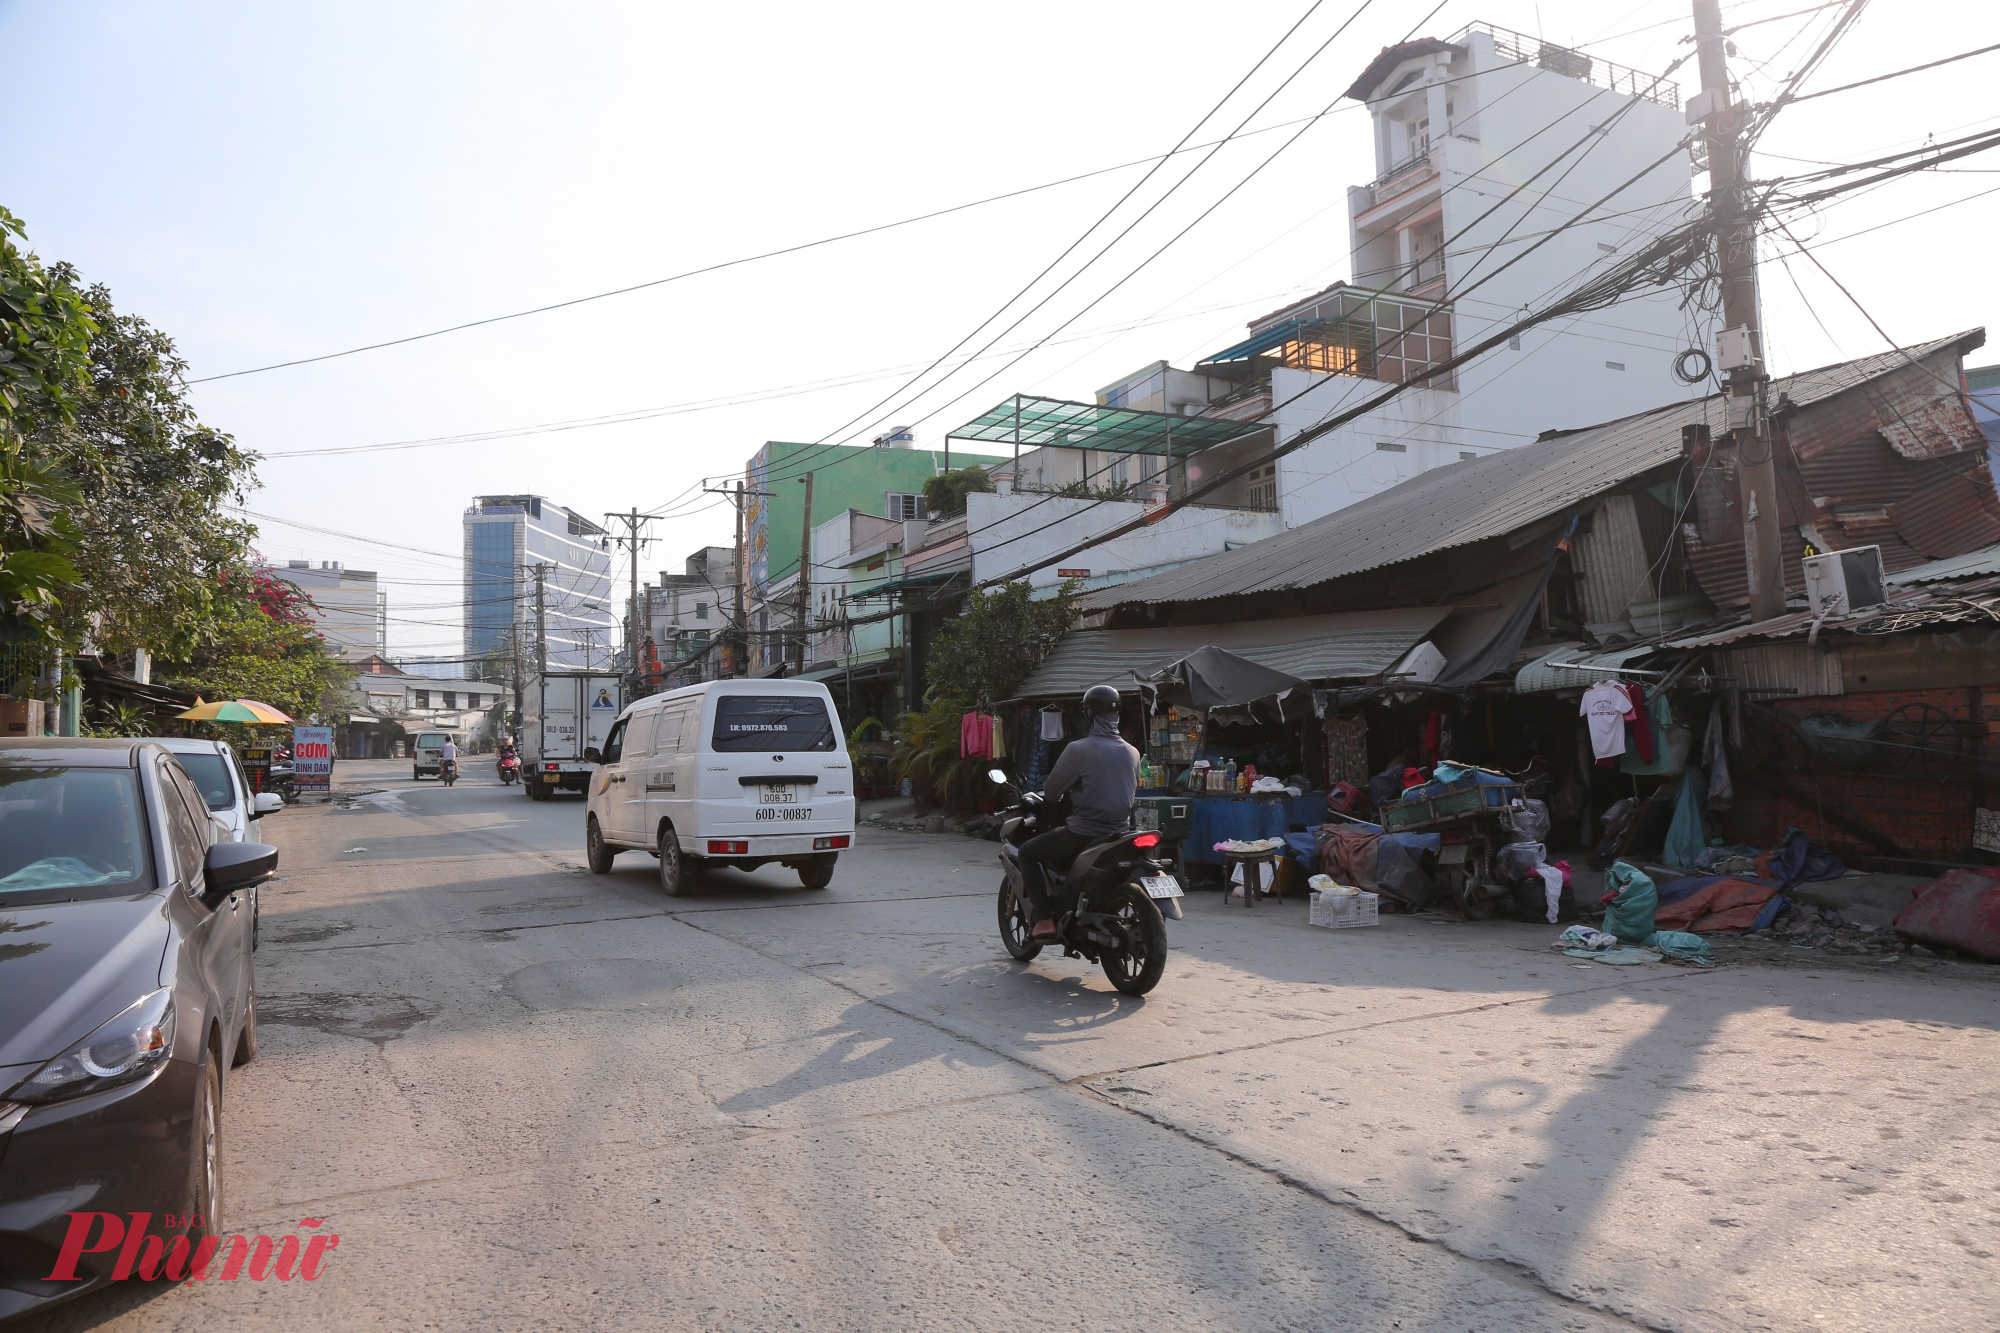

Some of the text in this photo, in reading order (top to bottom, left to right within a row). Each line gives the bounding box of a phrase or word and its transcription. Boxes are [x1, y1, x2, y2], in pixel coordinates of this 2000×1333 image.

[295, 741, 329, 759] CƠM
[314, 761, 329, 773] DÂN
[764, 793, 793, 802] 008.37
